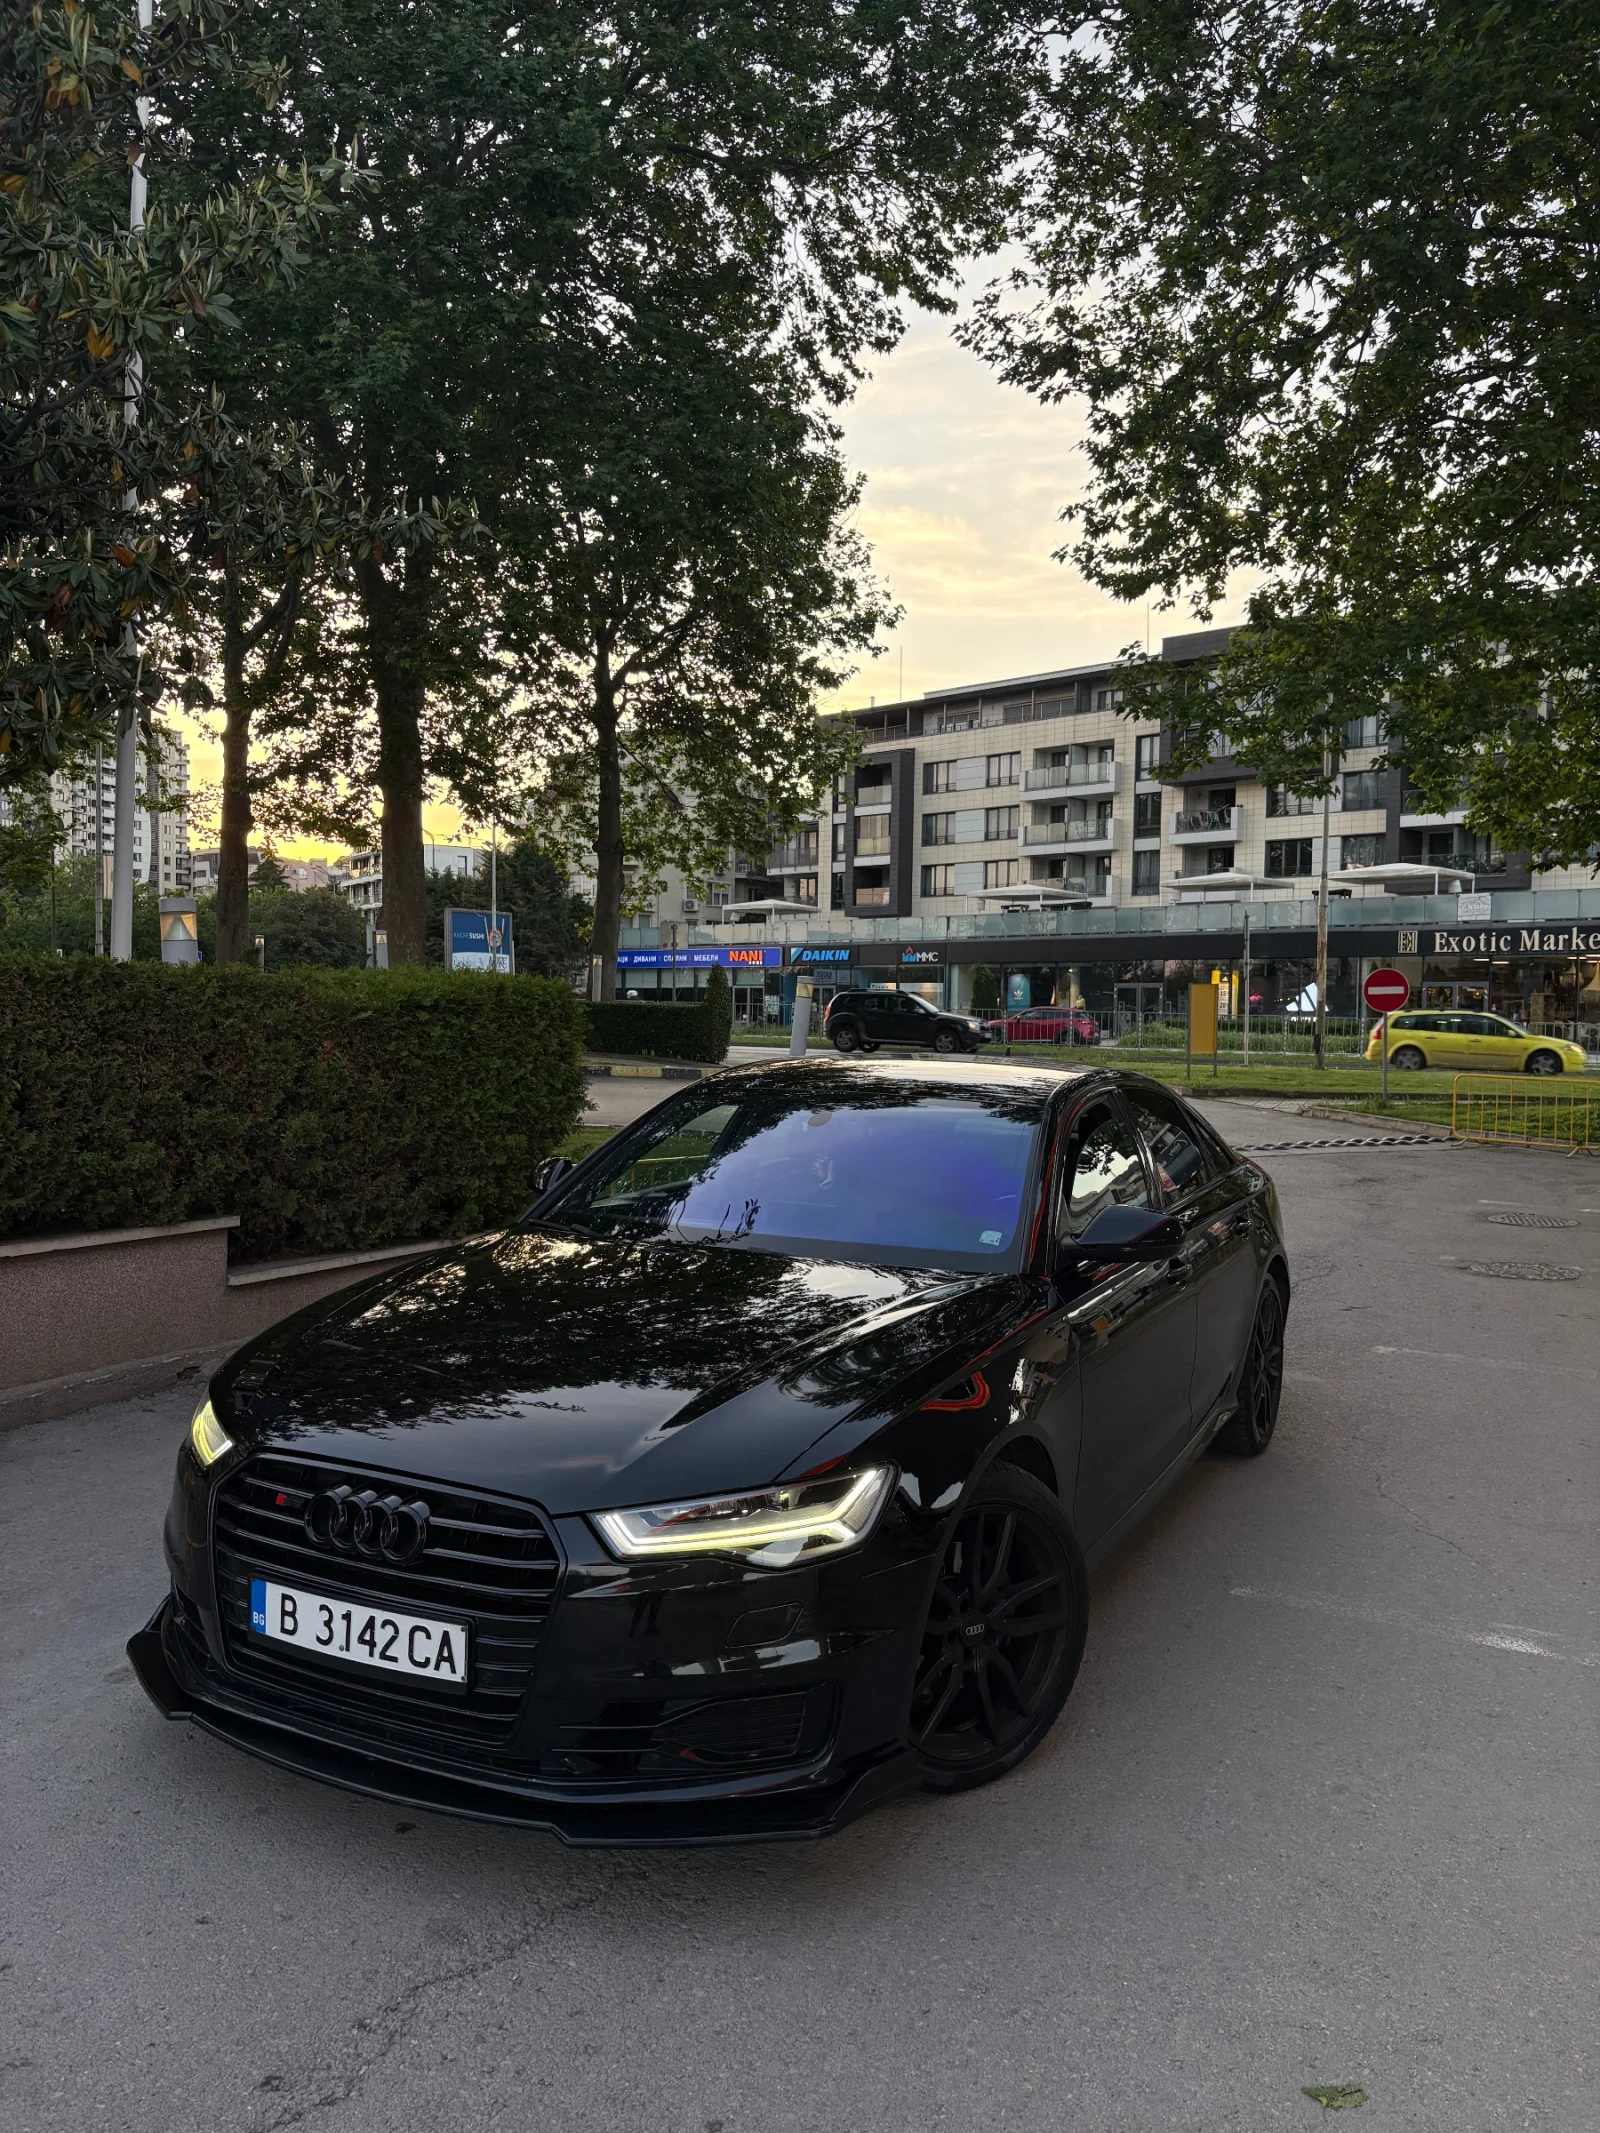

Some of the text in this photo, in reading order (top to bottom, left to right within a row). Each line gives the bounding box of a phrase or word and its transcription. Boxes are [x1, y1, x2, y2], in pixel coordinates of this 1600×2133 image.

[1433, 931, 1512, 953] Exotic
[633, 955, 657, 964] ДИВАНИ
[693, 954, 719, 962] МЕБЕЛИ
[729, 950, 763, 962] NANI
[802, 950, 850, 961] DAIKIN
[916, 952, 939, 962] MMC
[253, 1611, 265, 1626] BG
